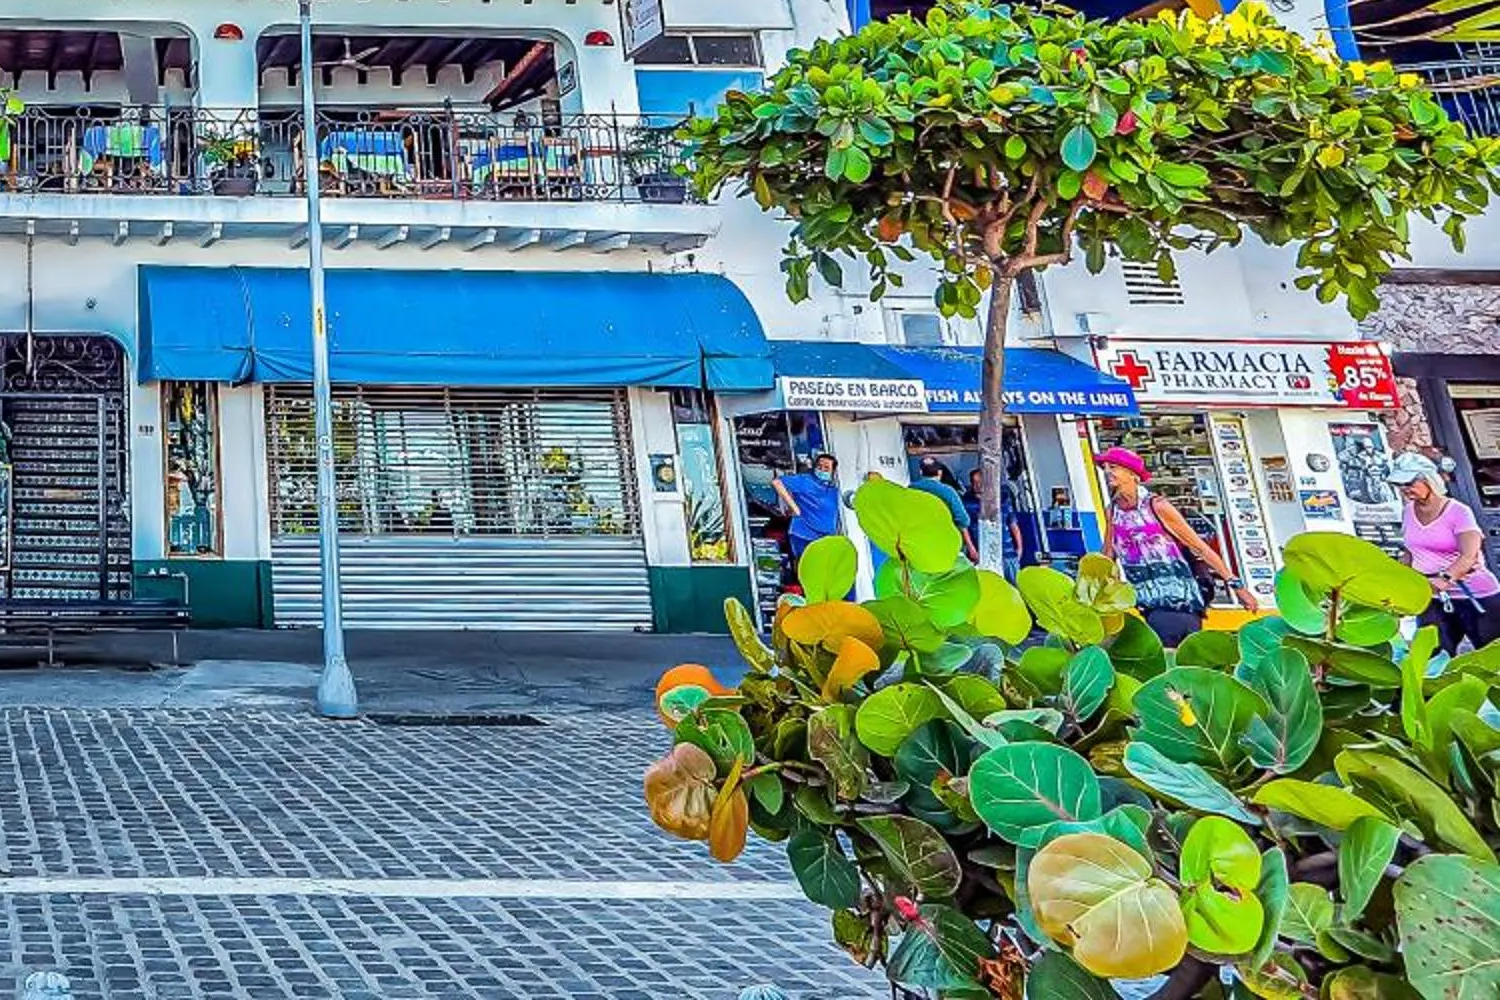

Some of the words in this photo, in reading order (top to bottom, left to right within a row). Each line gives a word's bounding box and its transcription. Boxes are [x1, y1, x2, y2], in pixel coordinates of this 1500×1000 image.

[1155, 350, 1313, 374] FARMACIA
[1162, 373, 1278, 390] PHARMACY
[1343, 365, 1388, 390] 85%
[789, 381, 845, 396] PASEOS
[847, 383, 867, 397] EN
[869, 384, 918, 398] BARCO
[926, 389, 958, 403] FISH
[1028, 391, 1055, 405] ON
[1057, 391, 1087, 406] THE
[1089, 393, 1129, 408] LINE!
